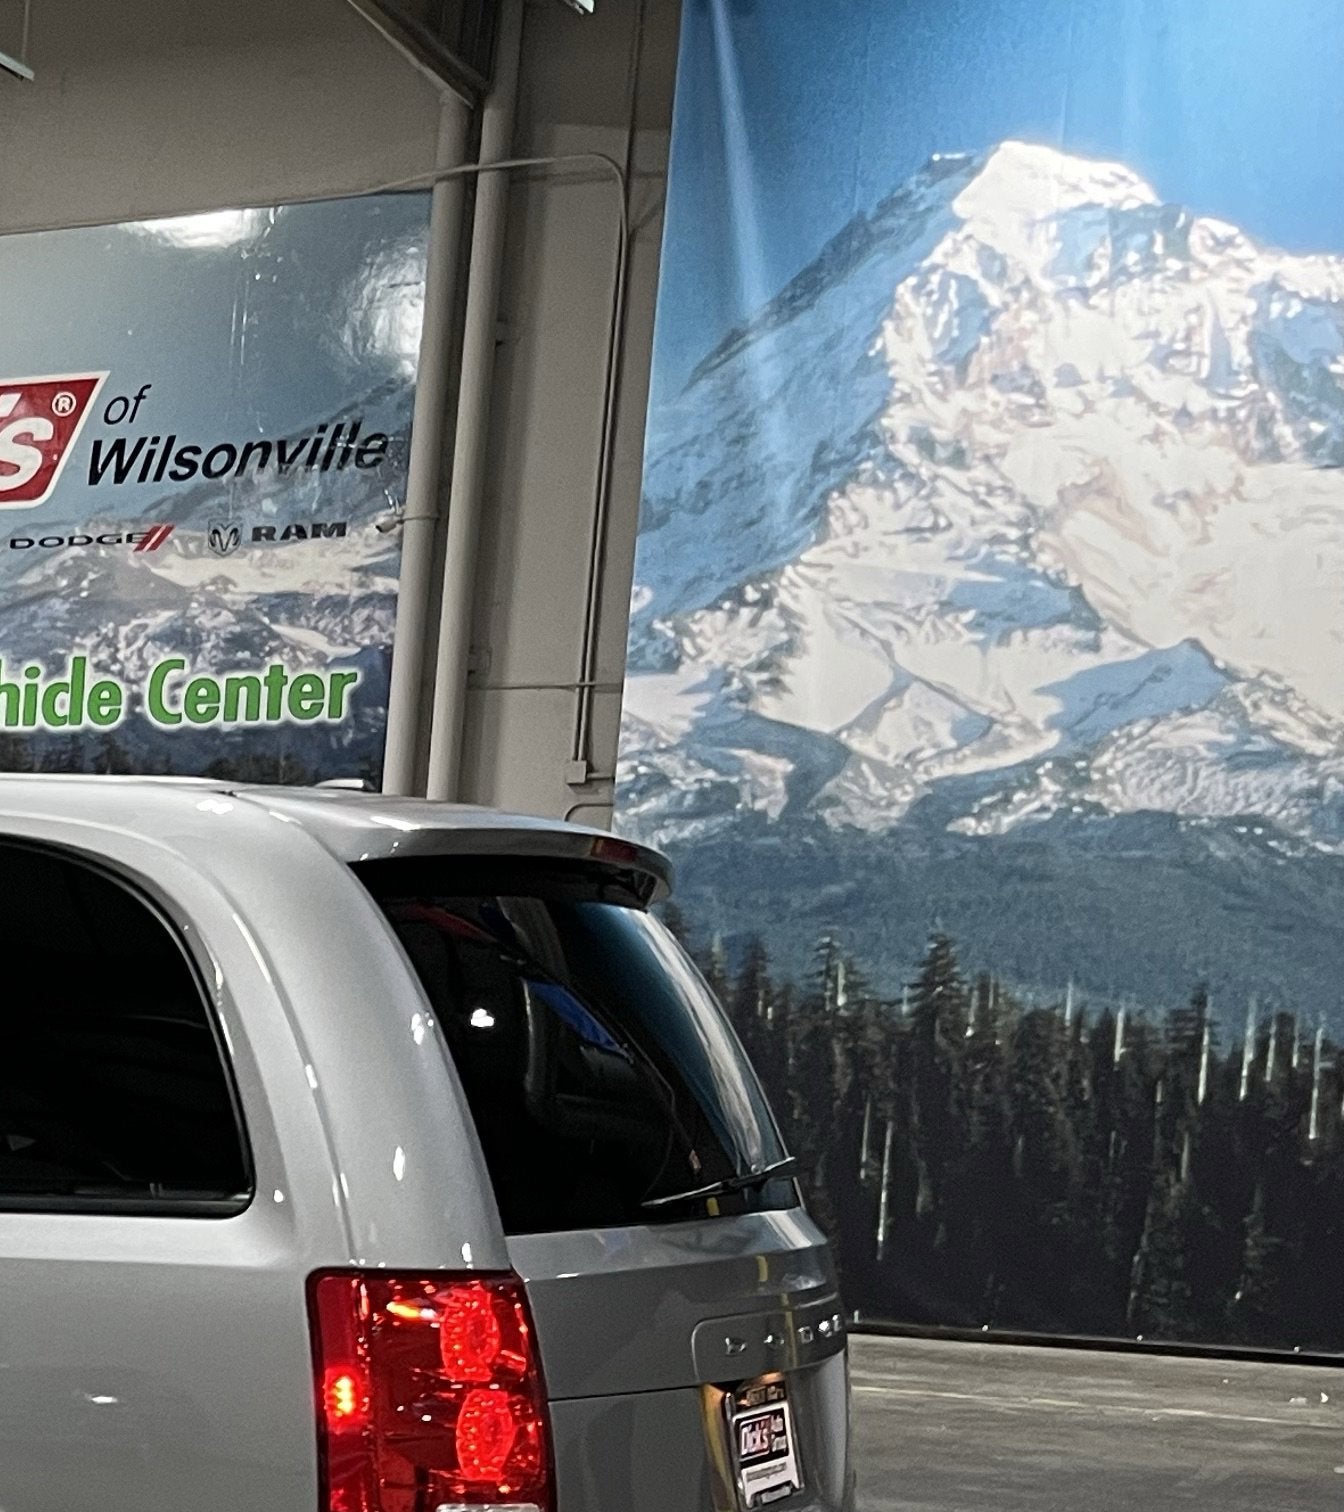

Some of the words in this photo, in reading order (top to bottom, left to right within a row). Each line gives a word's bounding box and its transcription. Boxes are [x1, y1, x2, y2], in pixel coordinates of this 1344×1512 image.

[103, 384, 152, 425] of
[87, 416, 390, 486] Wilsonville
[9, 532, 150, 550] DODGE
[251, 522, 348, 541] RAM
[148, 659, 358, 725] Center
